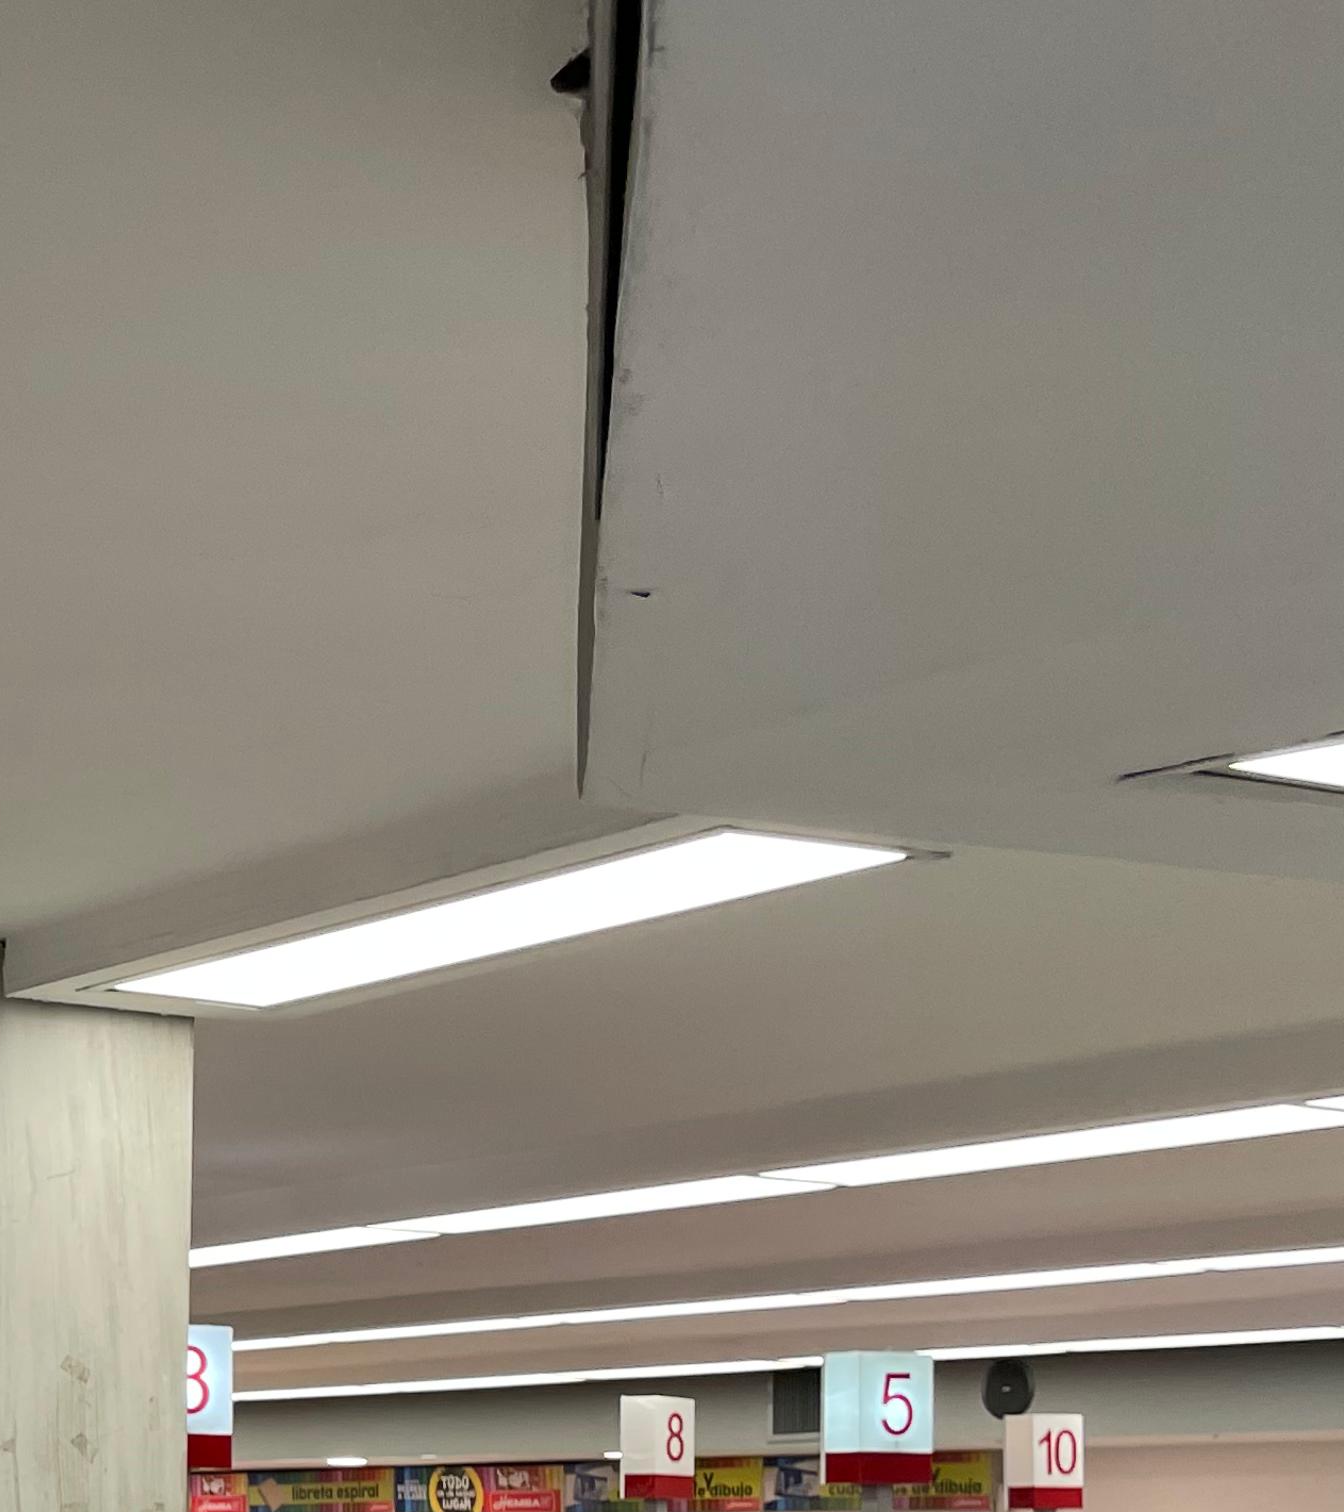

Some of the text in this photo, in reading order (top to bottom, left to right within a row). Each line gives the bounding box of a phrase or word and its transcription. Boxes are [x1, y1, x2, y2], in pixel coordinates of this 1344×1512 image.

[881, 1372, 913, 1436] 5
[666, 1412, 685, 1462] 8
[1038, 1427, 1078, 1476] 10
[291, 1484, 333, 1501] libreta
[336, 1483, 379, 1503] espiral
[440, 1475, 470, 1490] TODO
[712, 1480, 754, 1499] dibujo
